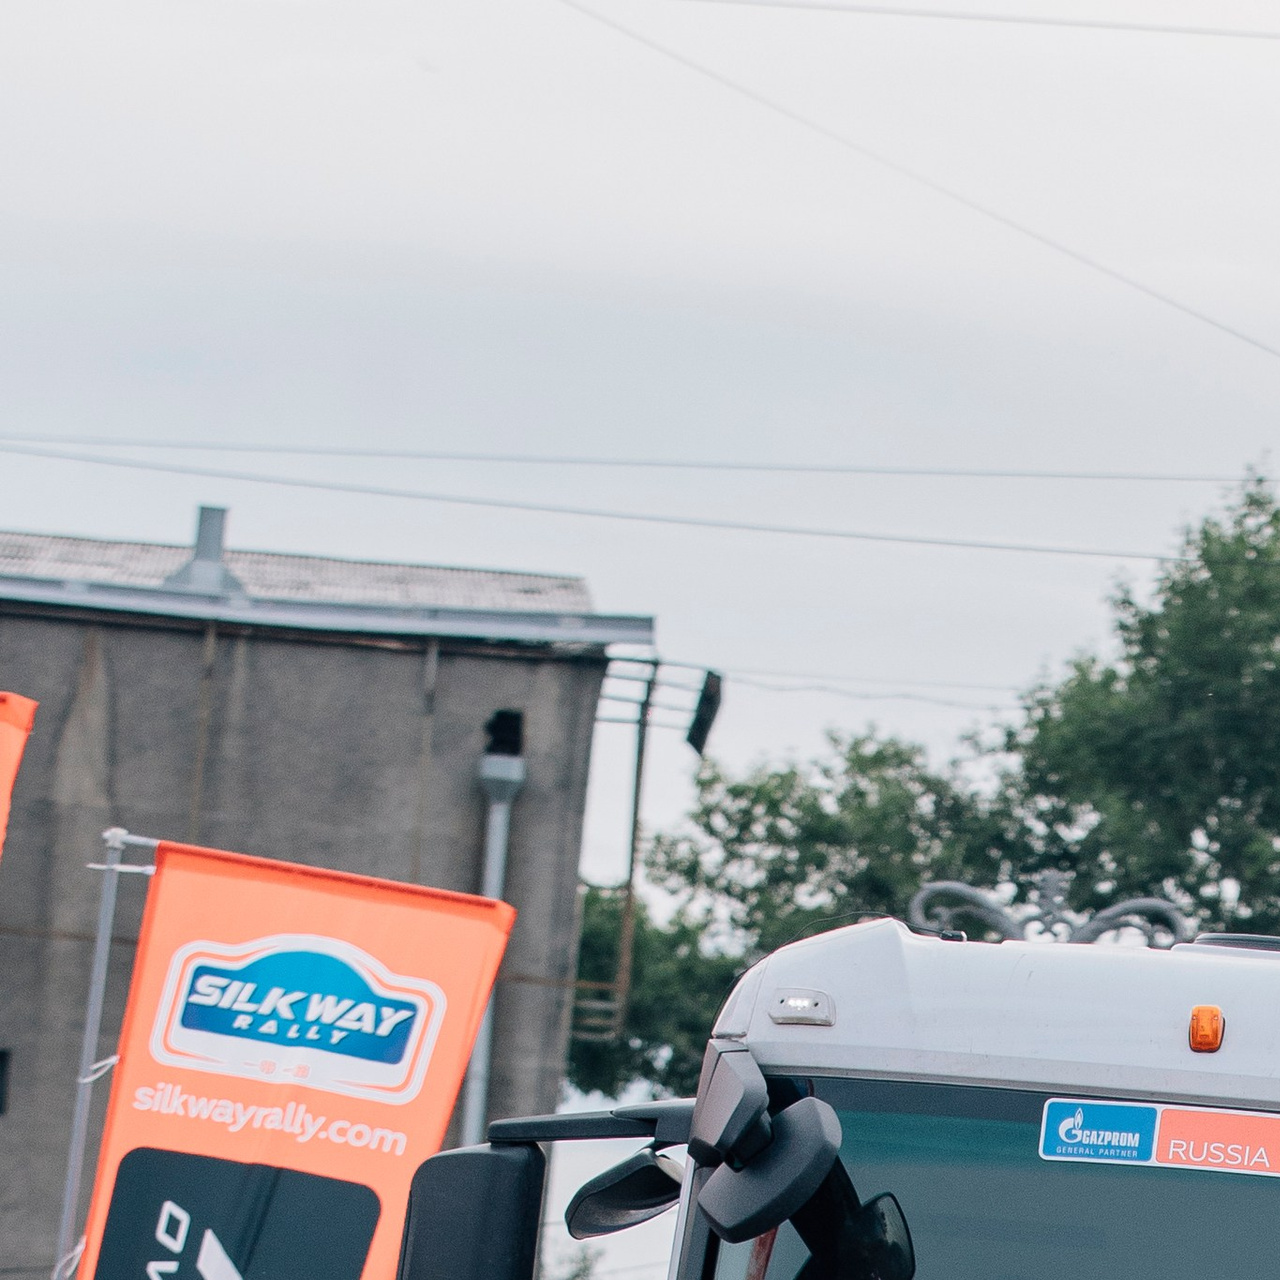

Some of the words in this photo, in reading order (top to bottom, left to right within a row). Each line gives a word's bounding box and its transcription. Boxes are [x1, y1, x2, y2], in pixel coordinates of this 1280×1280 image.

[188, 974, 307, 1020] SILK
[305, 993, 415, 1037] WAY
[232, 1014, 349, 1045] RALLY
[133, 1082, 408, 1156] silkwayrally.com
[1056, 1146, 1094, 1155] GENERAL
[1098, 1148, 1138, 1158] PARTNER
[1082, 1130, 1140, 1147] GAZPROM
[1168, 1140, 1270, 1168] RUSSIA
